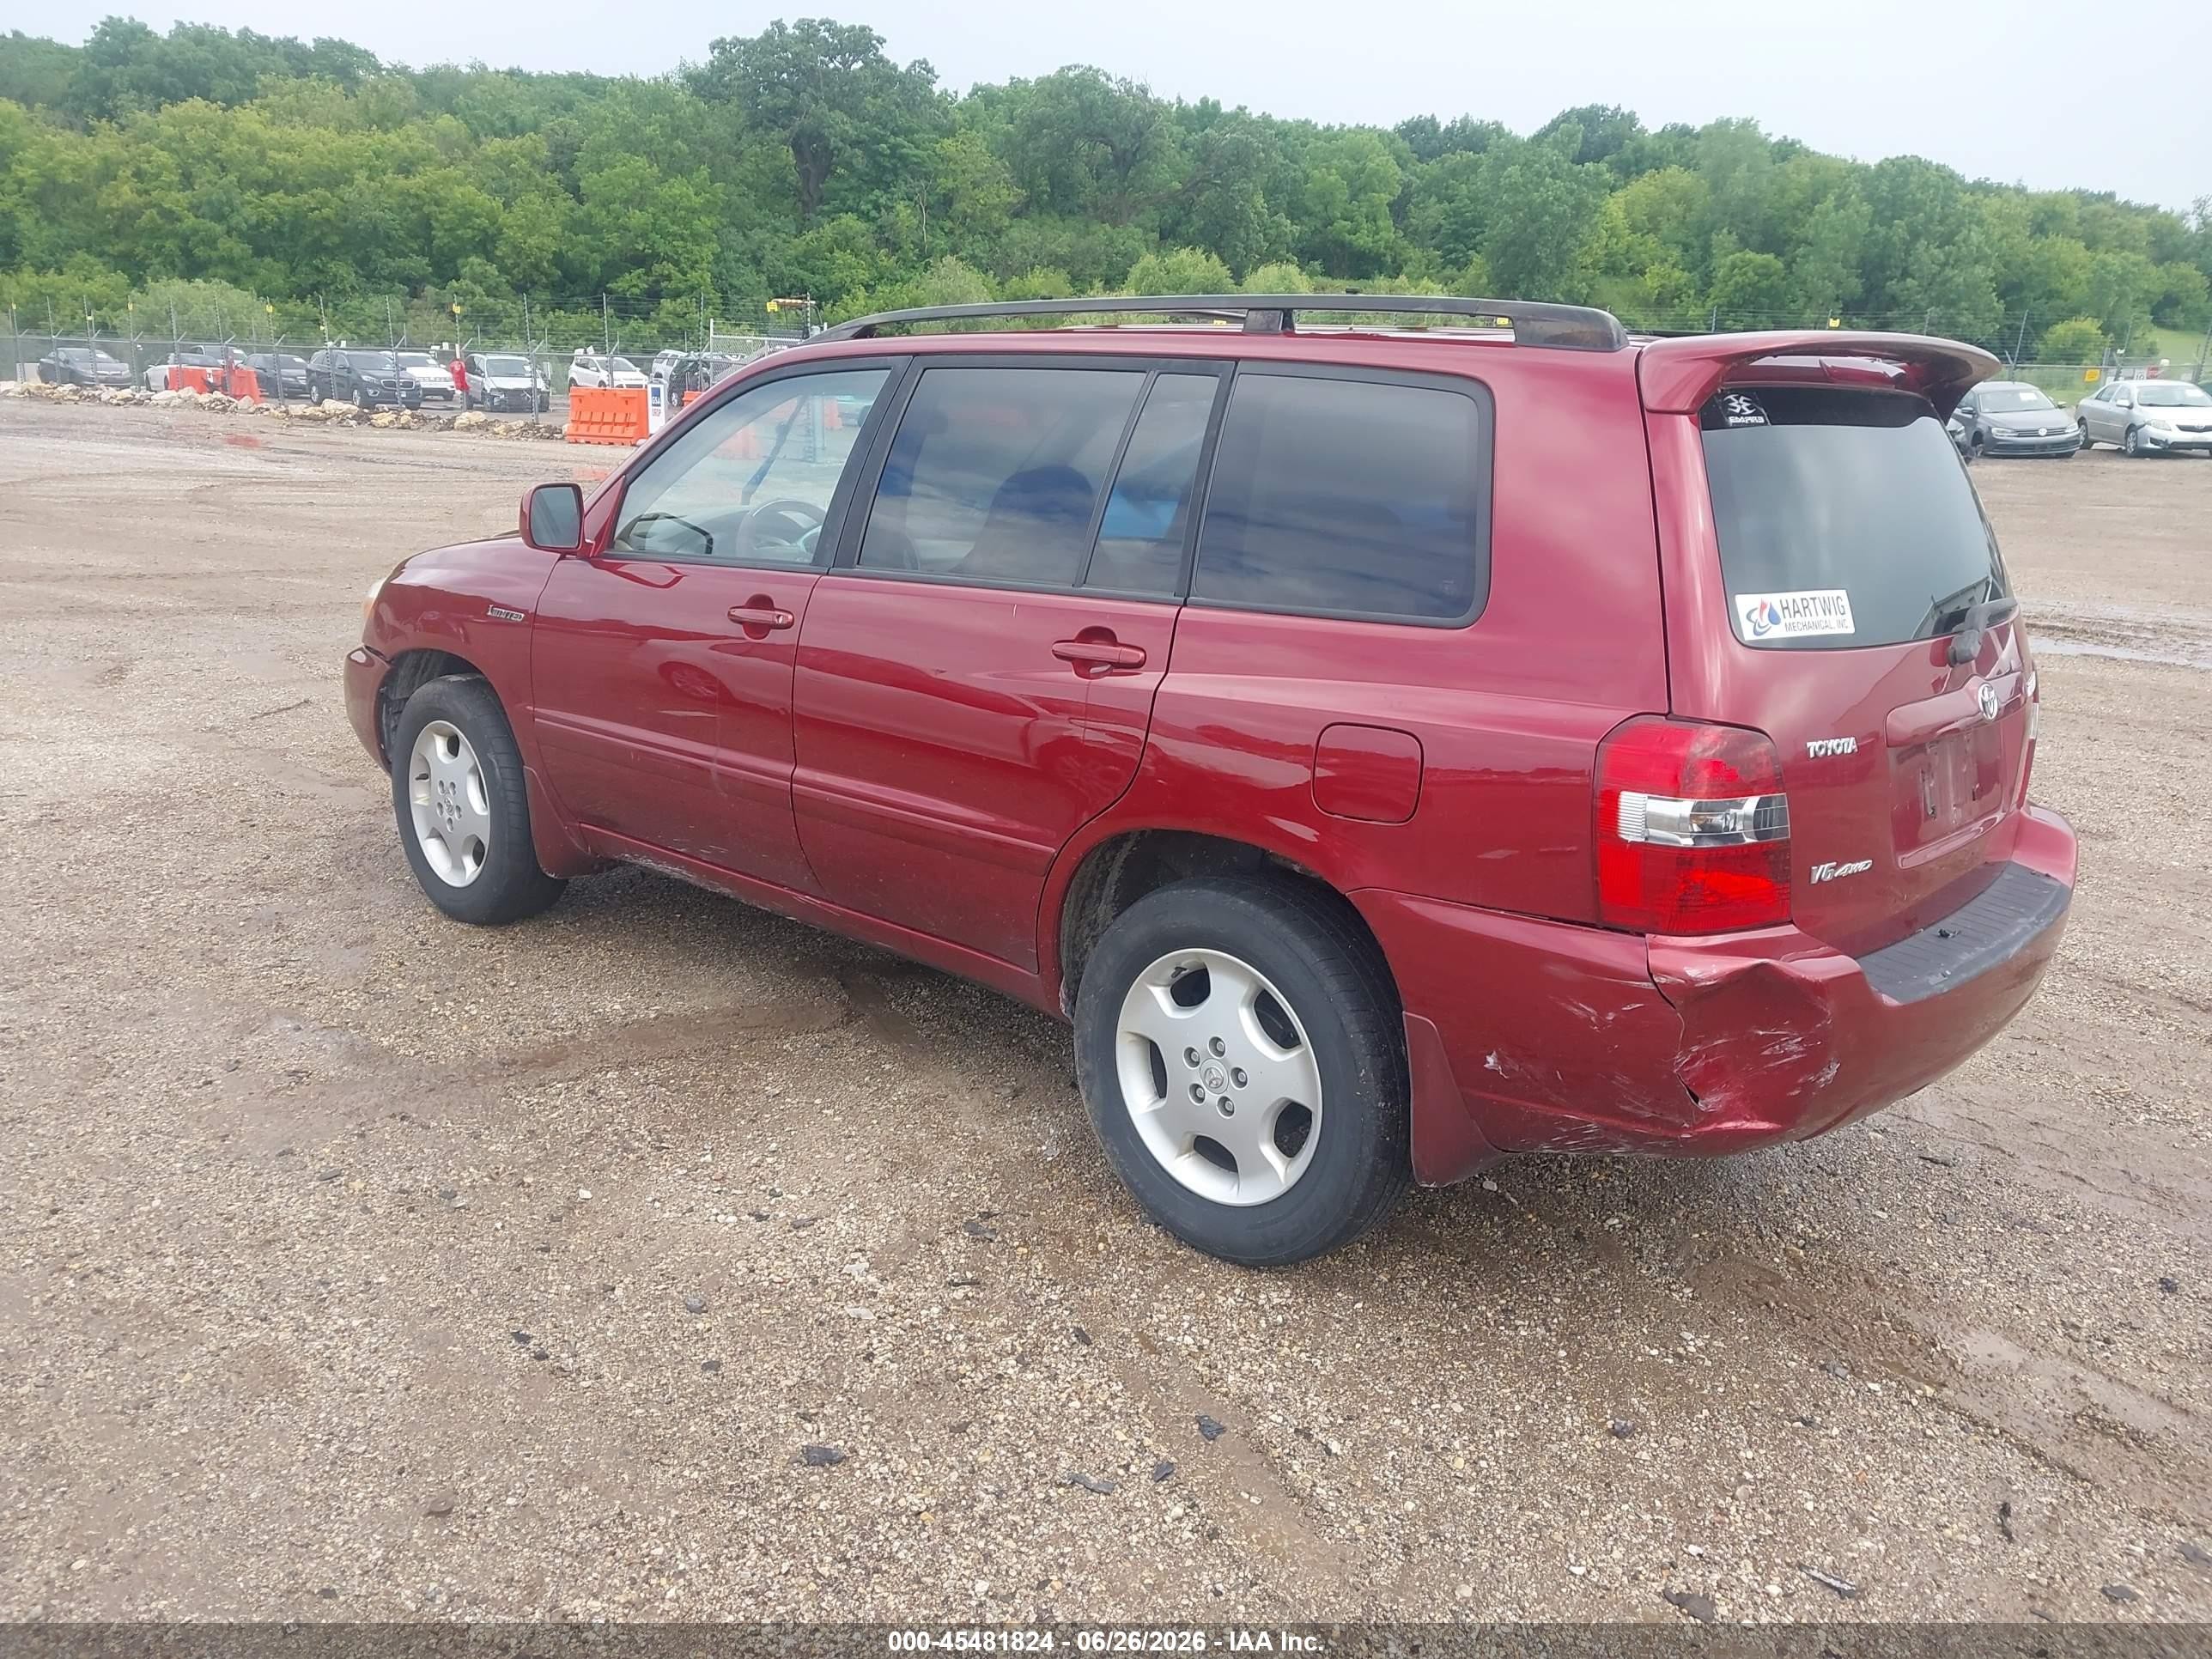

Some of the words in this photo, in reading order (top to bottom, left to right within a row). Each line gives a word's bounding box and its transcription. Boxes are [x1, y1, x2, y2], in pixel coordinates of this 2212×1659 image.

[1779, 596, 1845, 618] HARTWIG
[1806, 737, 1858, 758] TOYOTA
[1811, 861, 1837, 884] V6
